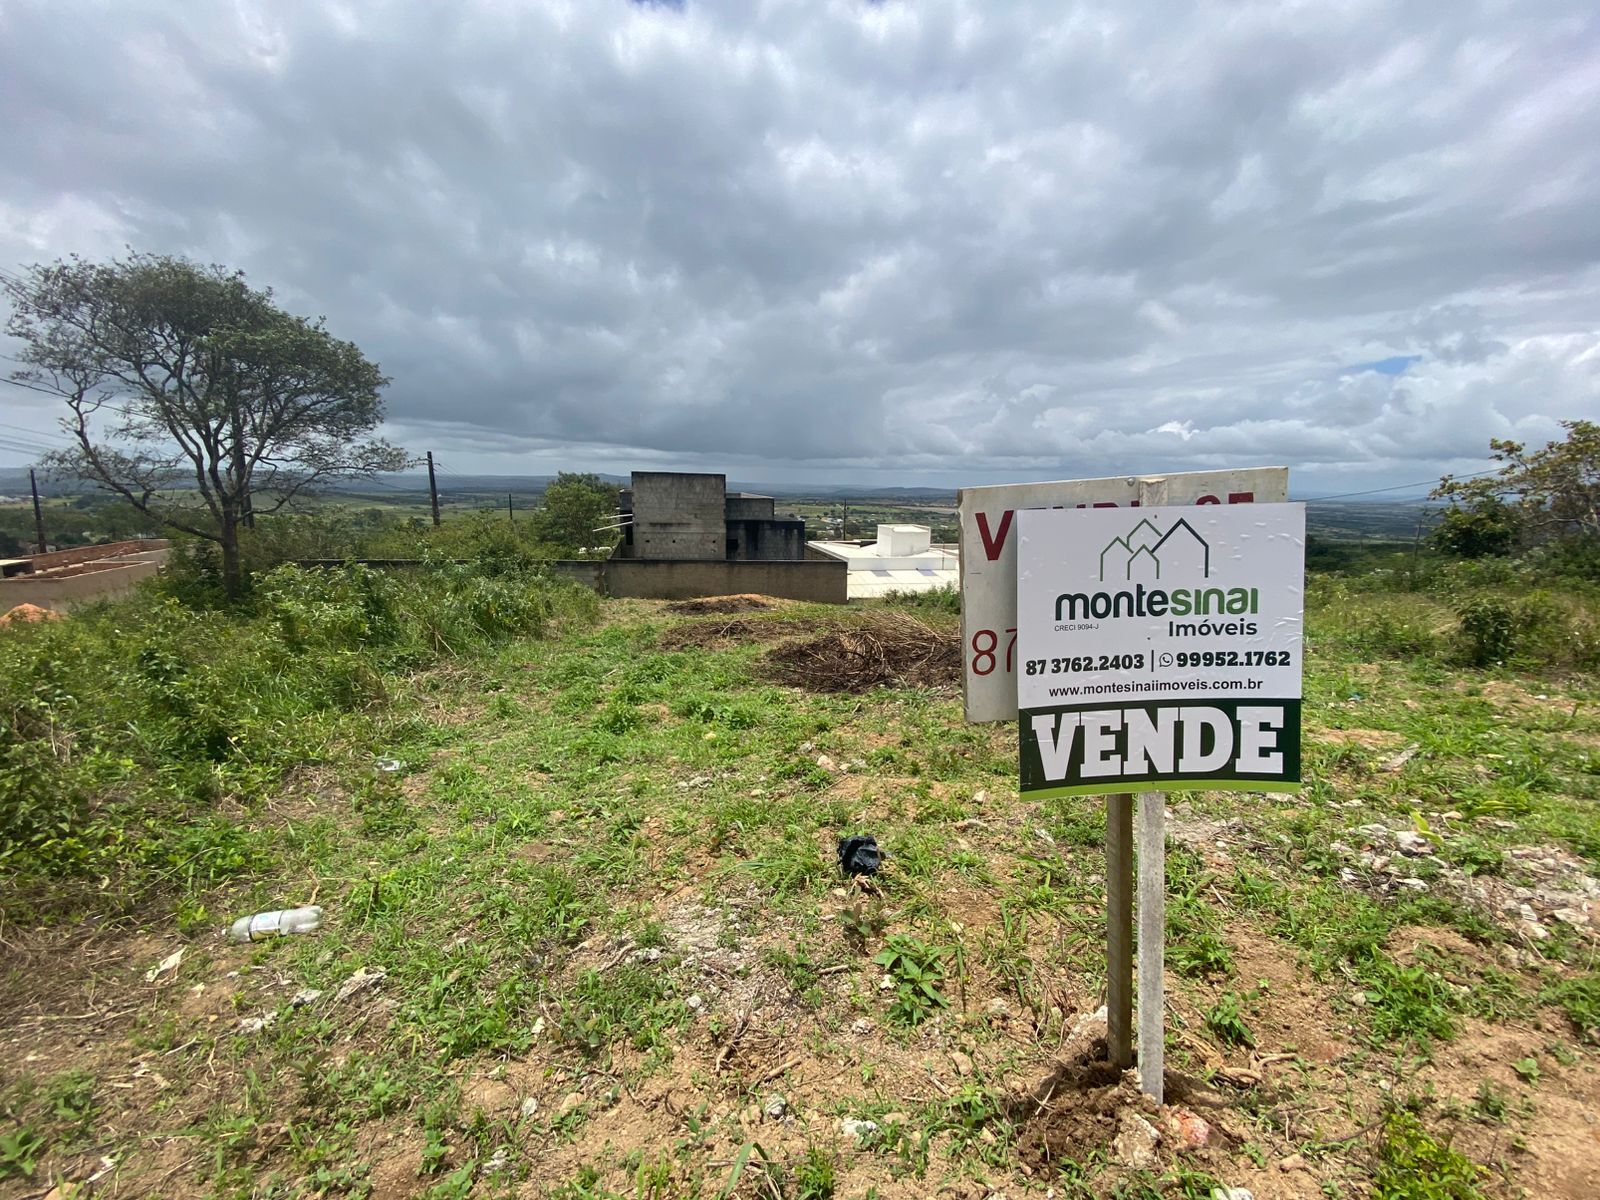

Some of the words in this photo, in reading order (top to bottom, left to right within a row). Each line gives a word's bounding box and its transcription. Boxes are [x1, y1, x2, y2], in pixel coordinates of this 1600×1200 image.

[1077, 623, 1099, 631] 9094-J
[1168, 618, 1258, 637] Imóveis
[1025, 659, 1047, 675] 87
[1050, 653, 1145, 673] 3762.2403
[1176, 651, 1291, 668] 99952.1762
[1048, 678, 1264, 697] www.montesinaiimoveis.com.br
[1031, 706, 1285, 782] VENDE
